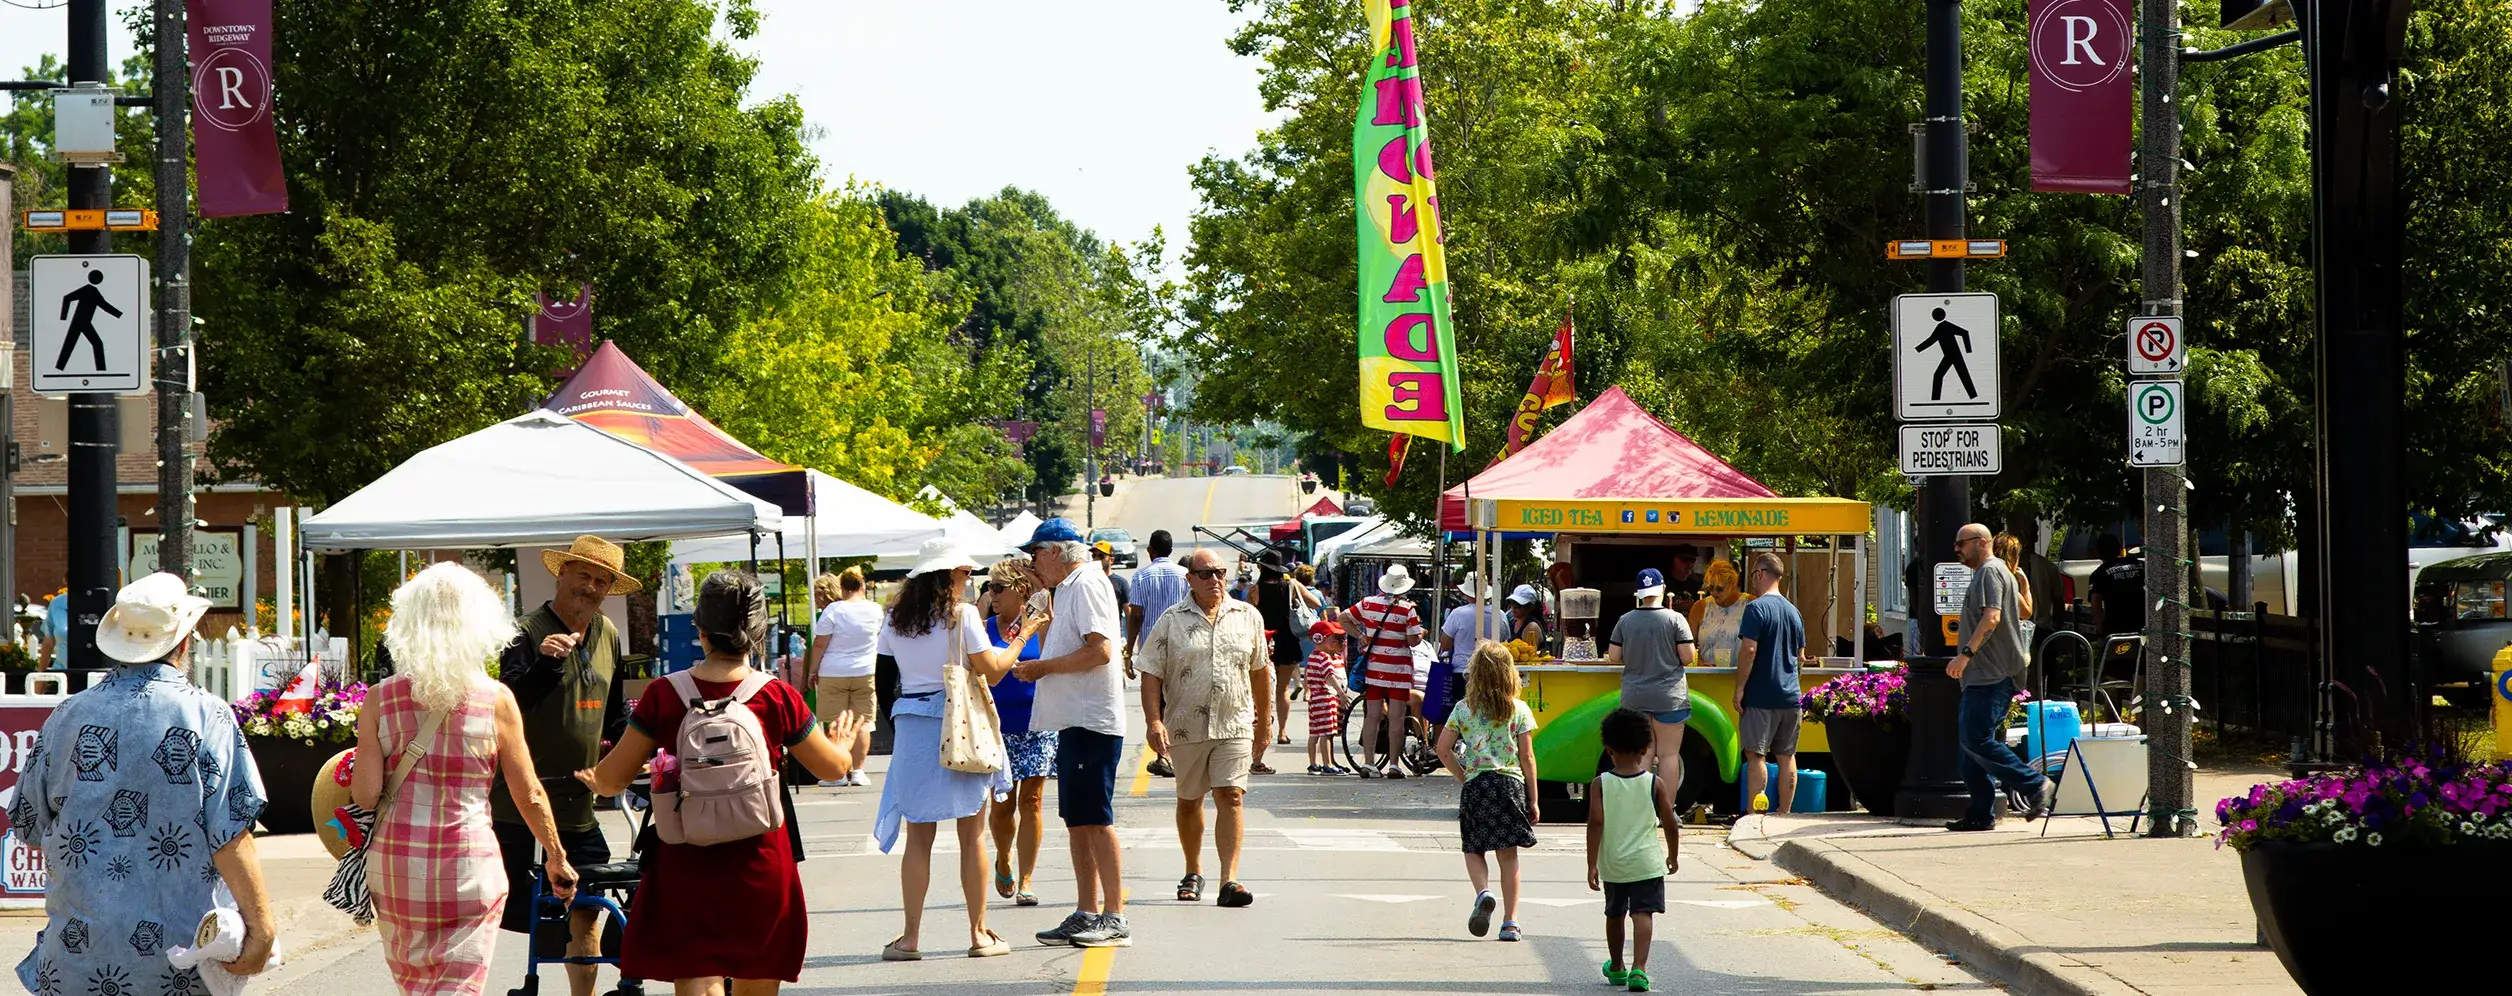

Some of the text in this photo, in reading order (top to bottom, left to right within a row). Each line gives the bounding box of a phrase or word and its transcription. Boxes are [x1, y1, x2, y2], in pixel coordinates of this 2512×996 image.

[203, 24, 255, 34] DOWNTOWN
[208, 33, 251, 43] RIDGEWAY
[2060, 15, 2106, 66] R
[215, 66, 253, 110] R
[580, 388, 630, 399] GOURMET
[557, 399, 652, 415] CARIBBEAN SAUCES
[2148, 395, 2166, 416] P
[1921, 430, 1979, 448] STOP FOR
[2145, 426, 2168, 437] 2 hr
[1913, 450, 1988, 468] PEDESTRIANS
[1521, 508, 1563, 526] ICED
[1568, 508, 1604, 526] TEA
[1693, 508, 1790, 527] LEMONADE
[220, 542, 231, 554] &
[199, 559, 225, 570] INC.
